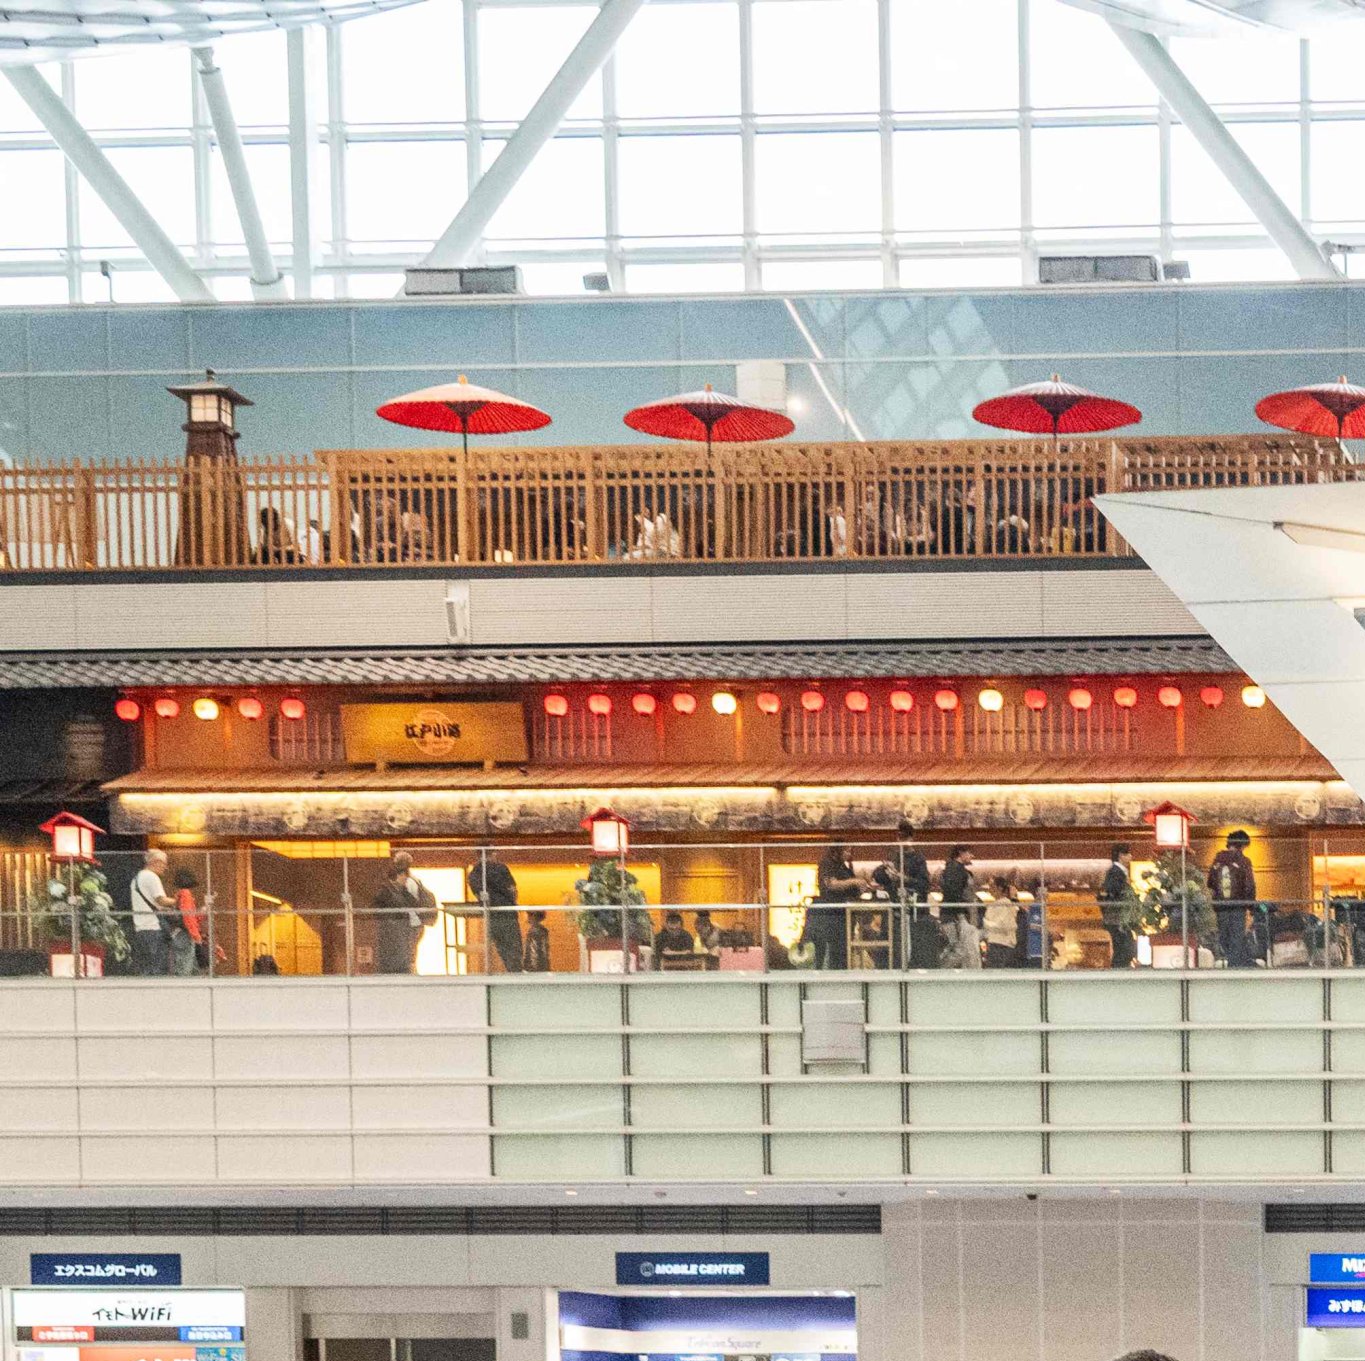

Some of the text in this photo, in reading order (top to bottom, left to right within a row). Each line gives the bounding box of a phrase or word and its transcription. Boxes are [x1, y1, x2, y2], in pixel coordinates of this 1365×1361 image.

[53, 1263, 158, 1278] エクスコムグローバル
[654, 1263, 746, 1275] MOBILE CENTER
